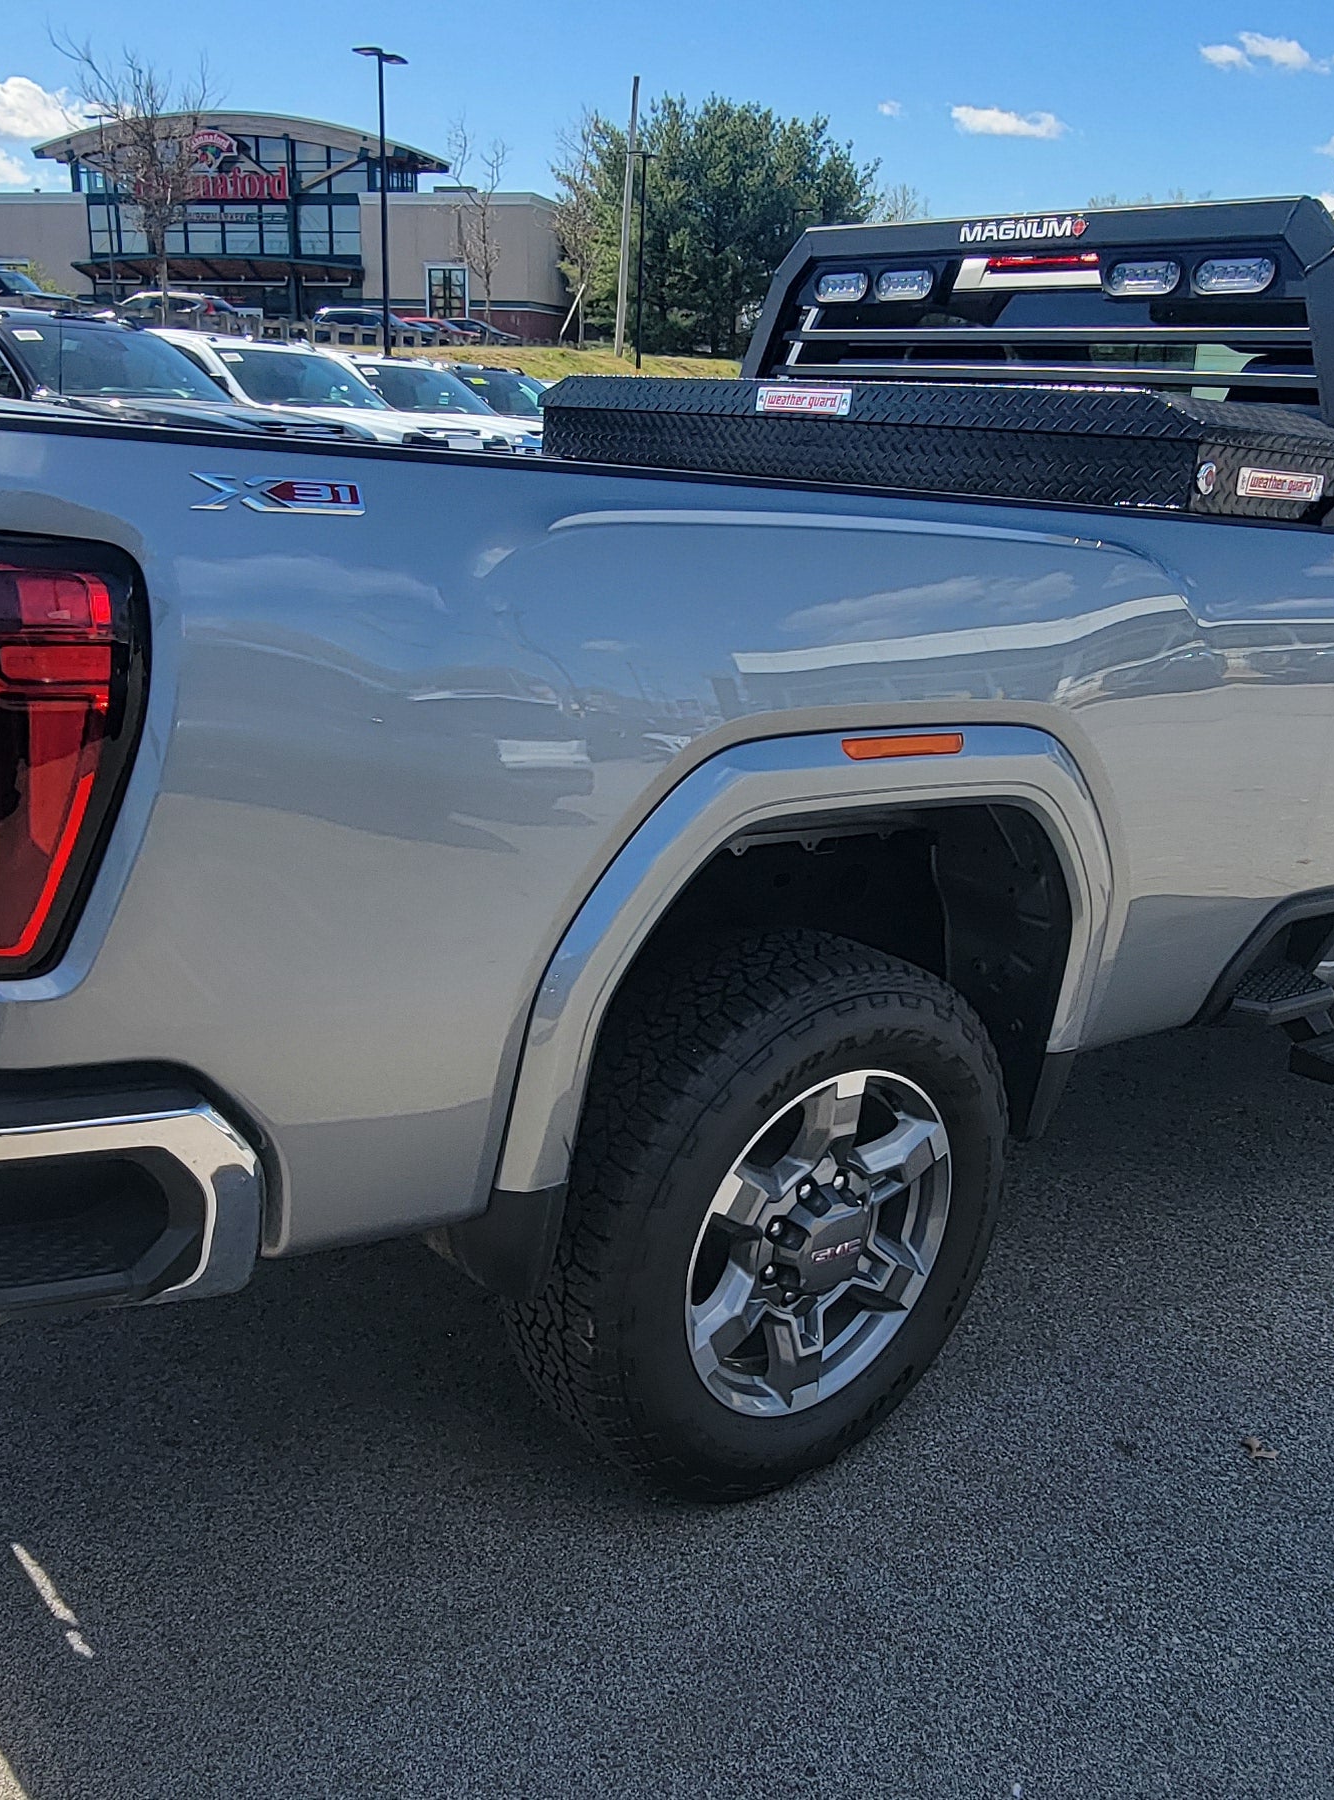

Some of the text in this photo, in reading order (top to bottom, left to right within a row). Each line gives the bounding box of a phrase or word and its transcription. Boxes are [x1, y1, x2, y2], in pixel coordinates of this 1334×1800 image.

[136, 167, 291, 200] naford
[959, 216, 1072, 243] MAGNUM
[767, 393, 838, 408] weather guard
[1250, 474, 1313, 493] weather guard
[810, 1238, 862, 1264] GMC
